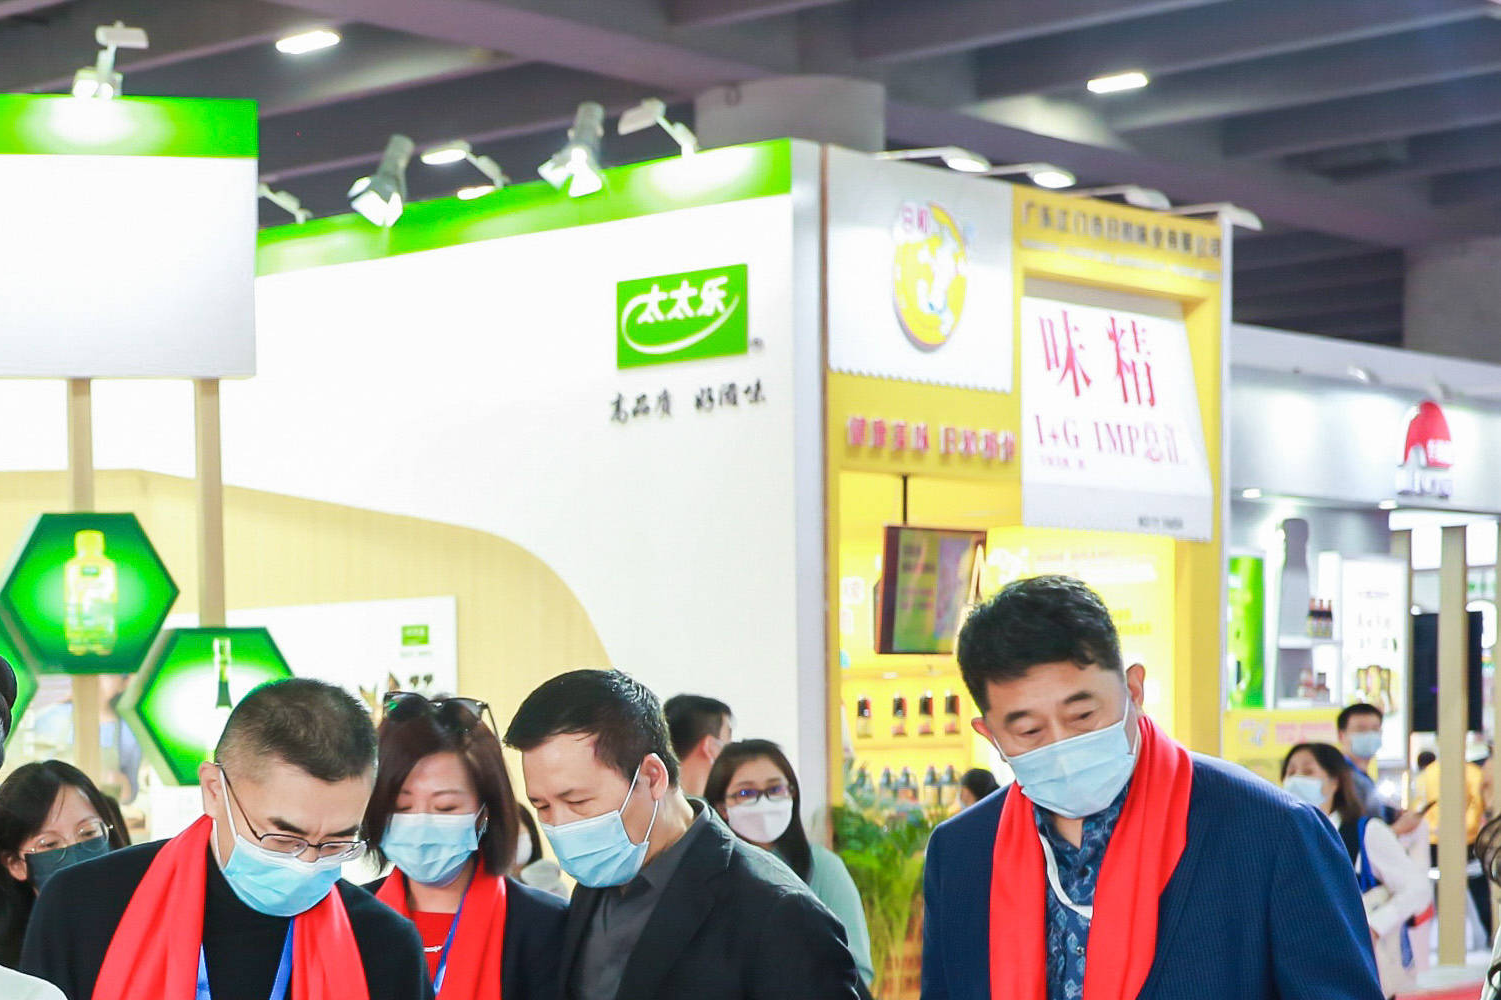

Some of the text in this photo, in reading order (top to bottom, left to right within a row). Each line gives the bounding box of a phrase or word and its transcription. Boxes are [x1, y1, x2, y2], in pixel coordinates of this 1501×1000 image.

[635, 275, 729, 325] 太太乐
[1038, 309, 1156, 408] 味精
